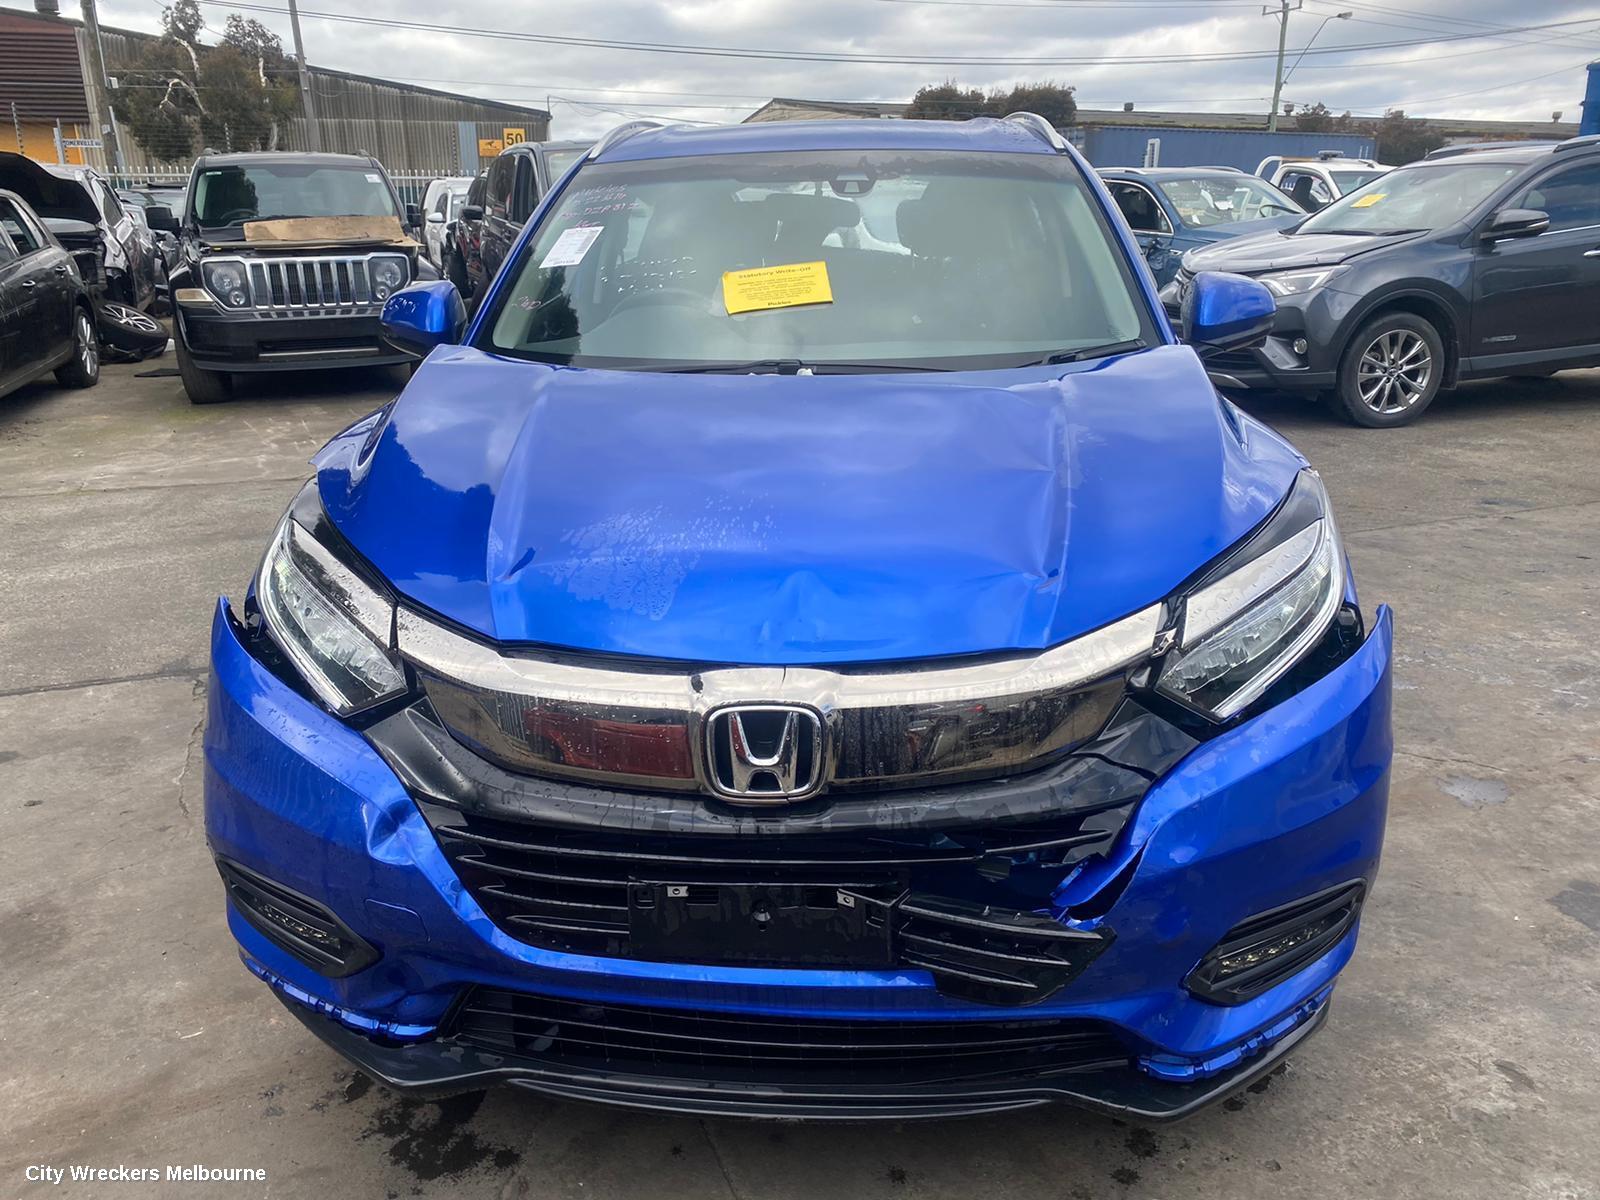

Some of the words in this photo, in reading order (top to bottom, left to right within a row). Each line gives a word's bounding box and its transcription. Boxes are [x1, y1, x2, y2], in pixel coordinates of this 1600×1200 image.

[506, 133, 523, 145] 50
[738, 271, 774, 279] Statutory
[775, 266, 811, 274] Write-Off
